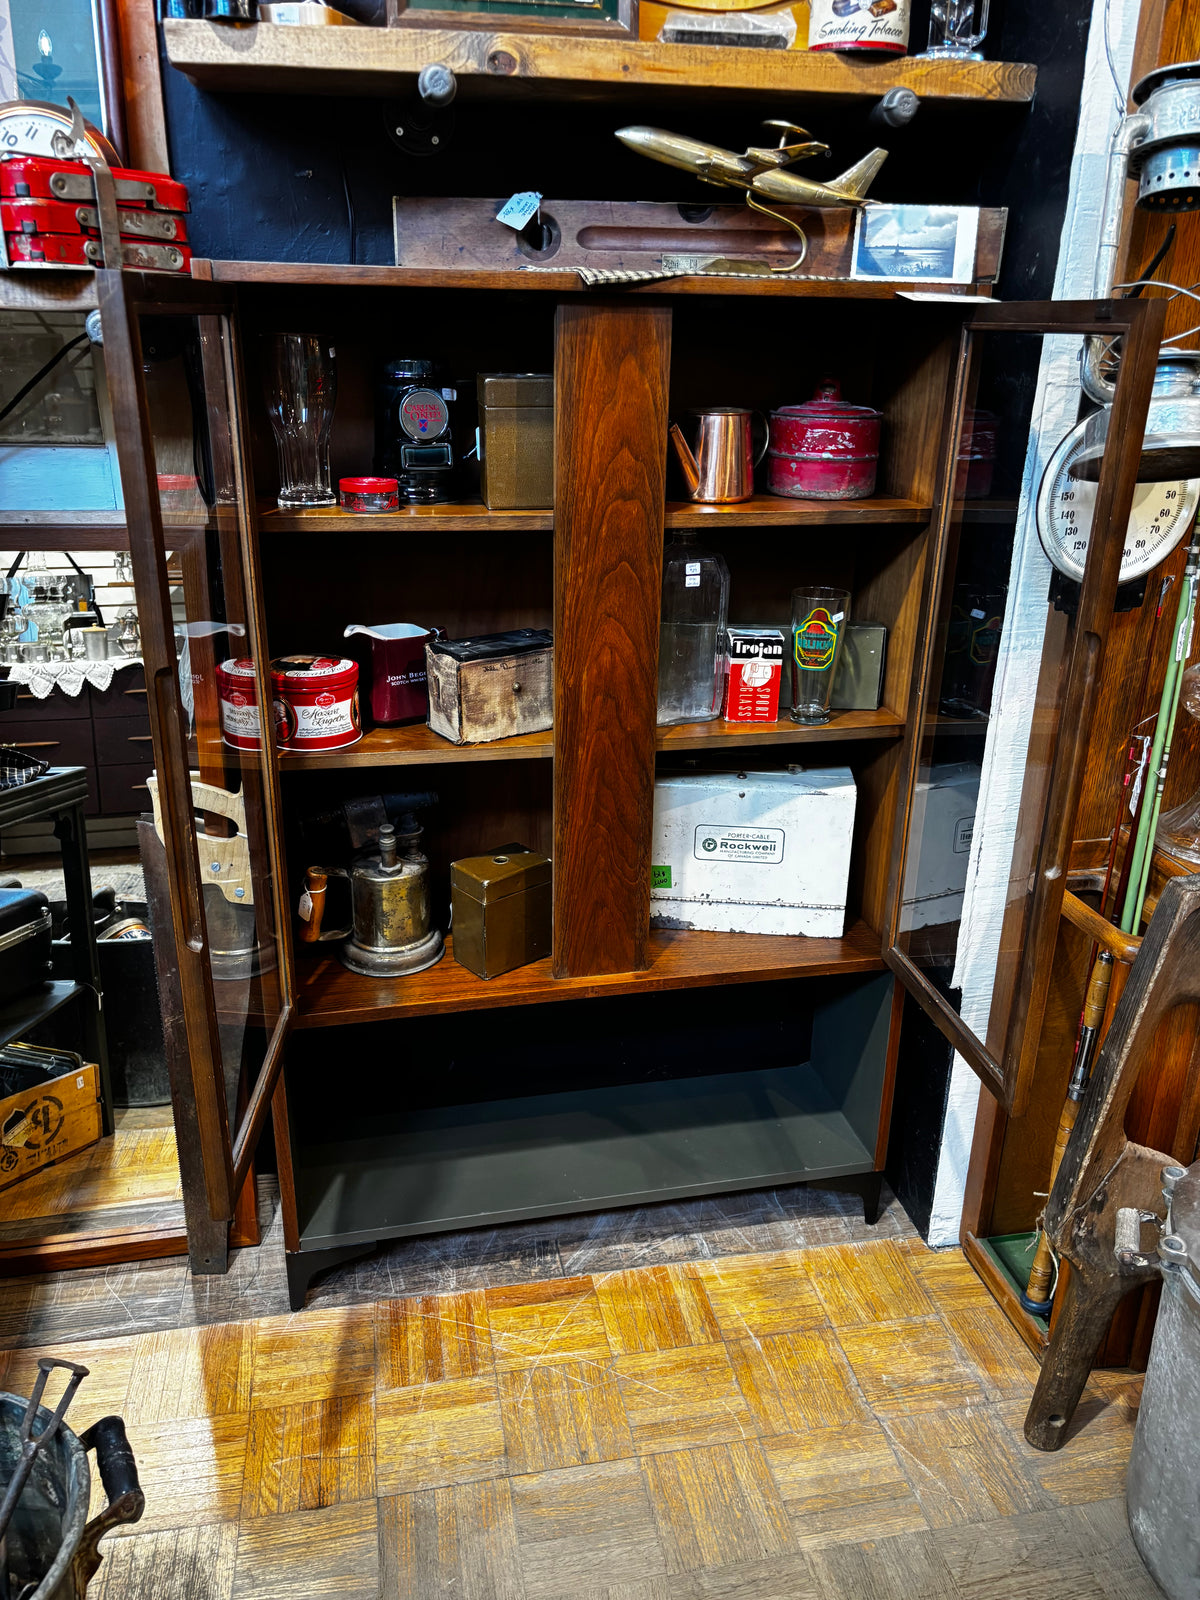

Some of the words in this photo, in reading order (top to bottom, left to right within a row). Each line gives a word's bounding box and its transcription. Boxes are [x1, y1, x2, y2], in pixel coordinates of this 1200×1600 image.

[819, 20, 867, 42] Smoking
[868, 18, 904, 38] Tobacco
[2, 130, 18, 147] 10
[1061, 491, 1075, 501] 150
[1165, 490, 1177, 500] 50
[1060, 510, 1075, 520] 140
[1159, 508, 1170, 518] 60
[1064, 526, 1078, 536] 130
[1150, 525, 1160, 534] 70
[1073, 540, 1087, 550] 120
[1135, 539, 1146, 549] 80
[734, 640, 783, 658] Trojan
[386, 674, 406, 683] JOHN
[738, 688, 753, 717] GLASS
[755, 688, 770, 717] SPORT
[728, 832, 770, 840] PORTER-CABLE
[720, 841, 776, 851] Rockwell
